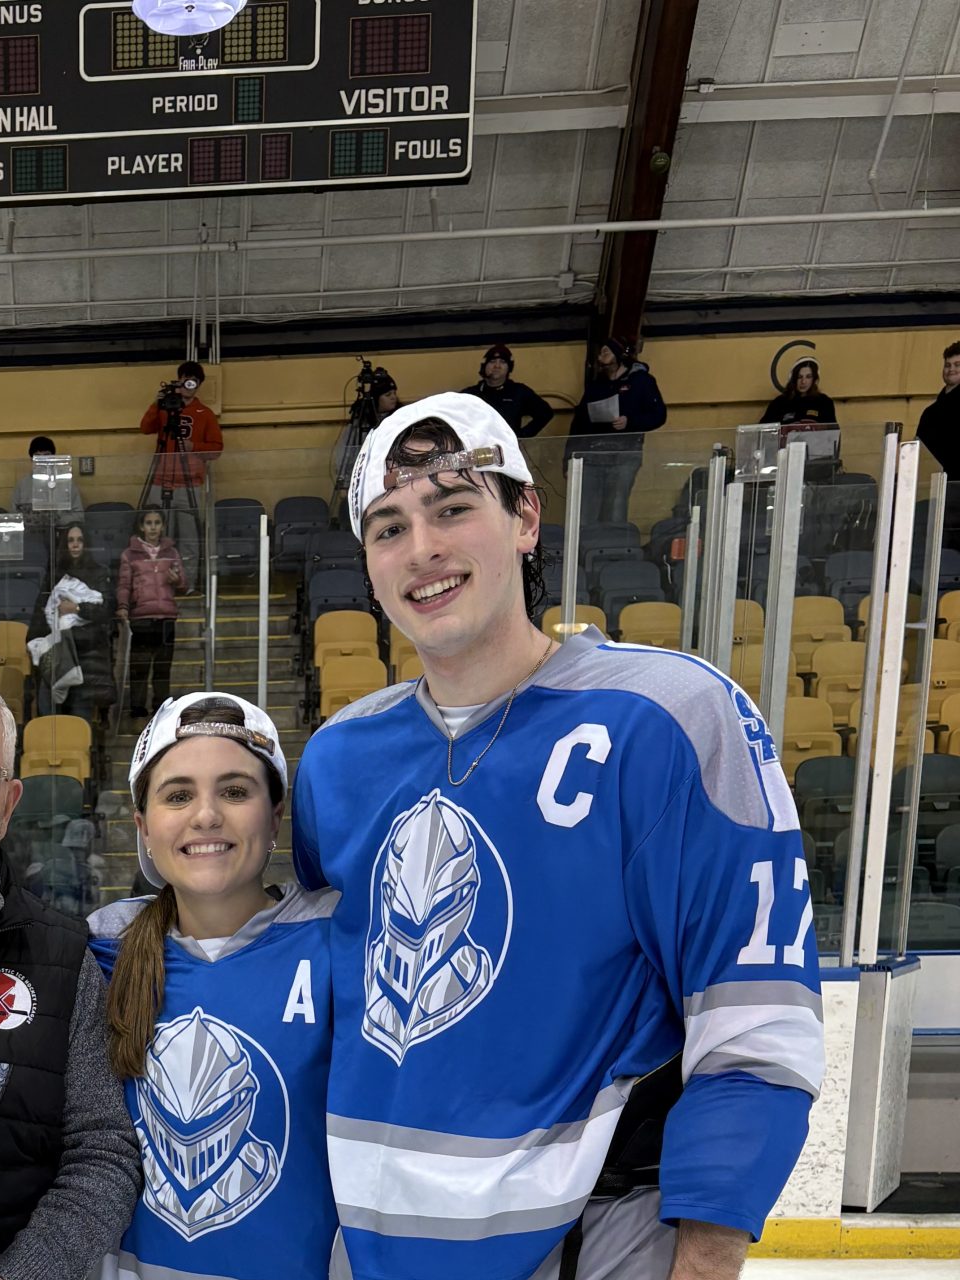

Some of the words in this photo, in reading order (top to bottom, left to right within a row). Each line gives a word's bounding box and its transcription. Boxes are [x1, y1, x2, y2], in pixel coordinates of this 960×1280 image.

[152, 94, 218, 113] PERIOD
[340, 85, 449, 115] VISITOR
[15, 105, 57, 131] HALL
[394, 138, 462, 160] FOULS
[107, 153, 183, 175] PLAYER
[536, 723, 612, 828] C
[736, 857, 814, 968] 17
[282, 960, 316, 1024] A
